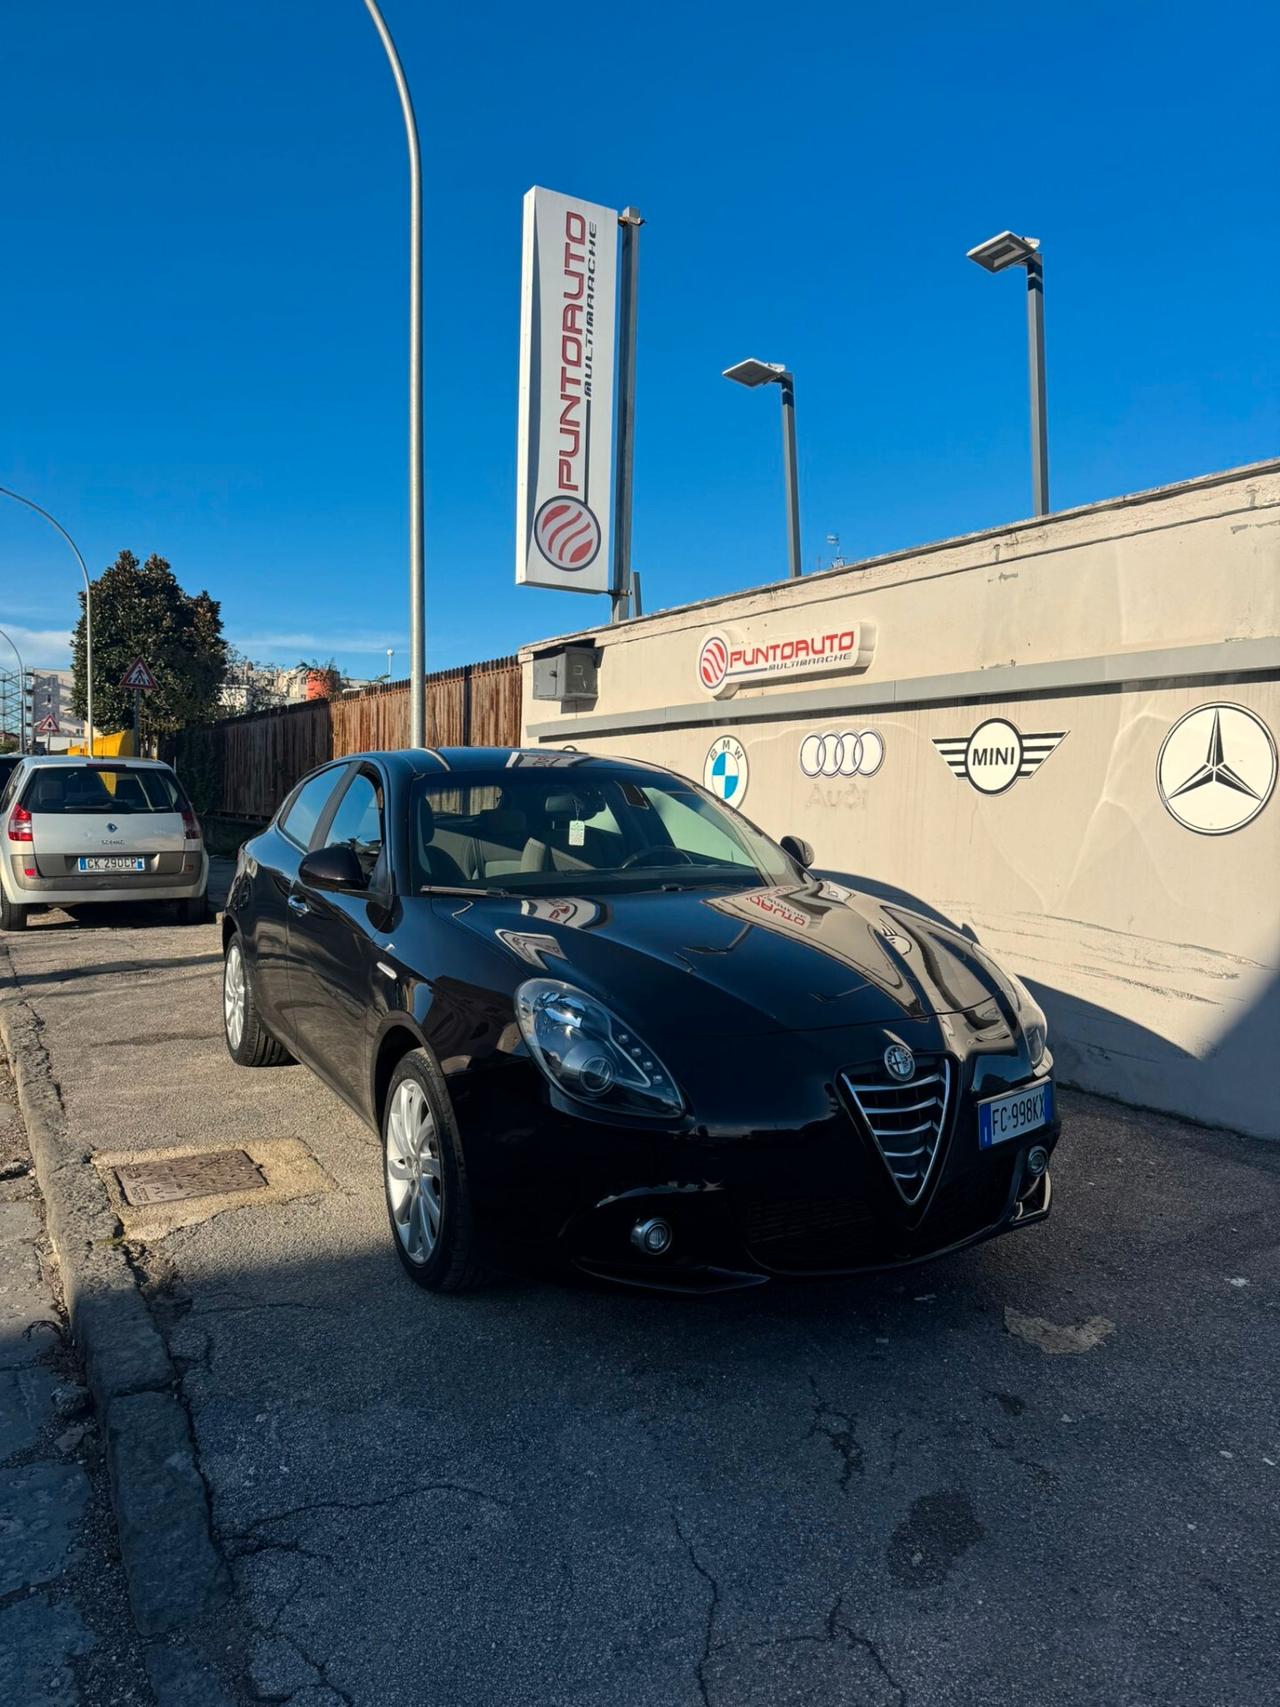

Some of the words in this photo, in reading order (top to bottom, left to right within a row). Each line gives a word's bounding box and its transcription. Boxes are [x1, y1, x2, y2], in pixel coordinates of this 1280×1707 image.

[584, 221, 598, 399] MULTIMARCHE
[558, 210, 587, 492] PUNTOAUTO
[729, 630, 855, 668] PUNTOAUTO
[768, 652, 852, 671] MULTIMARCHE
[710, 739, 743, 761] BMW
[972, 746, 1015, 767] MINI
